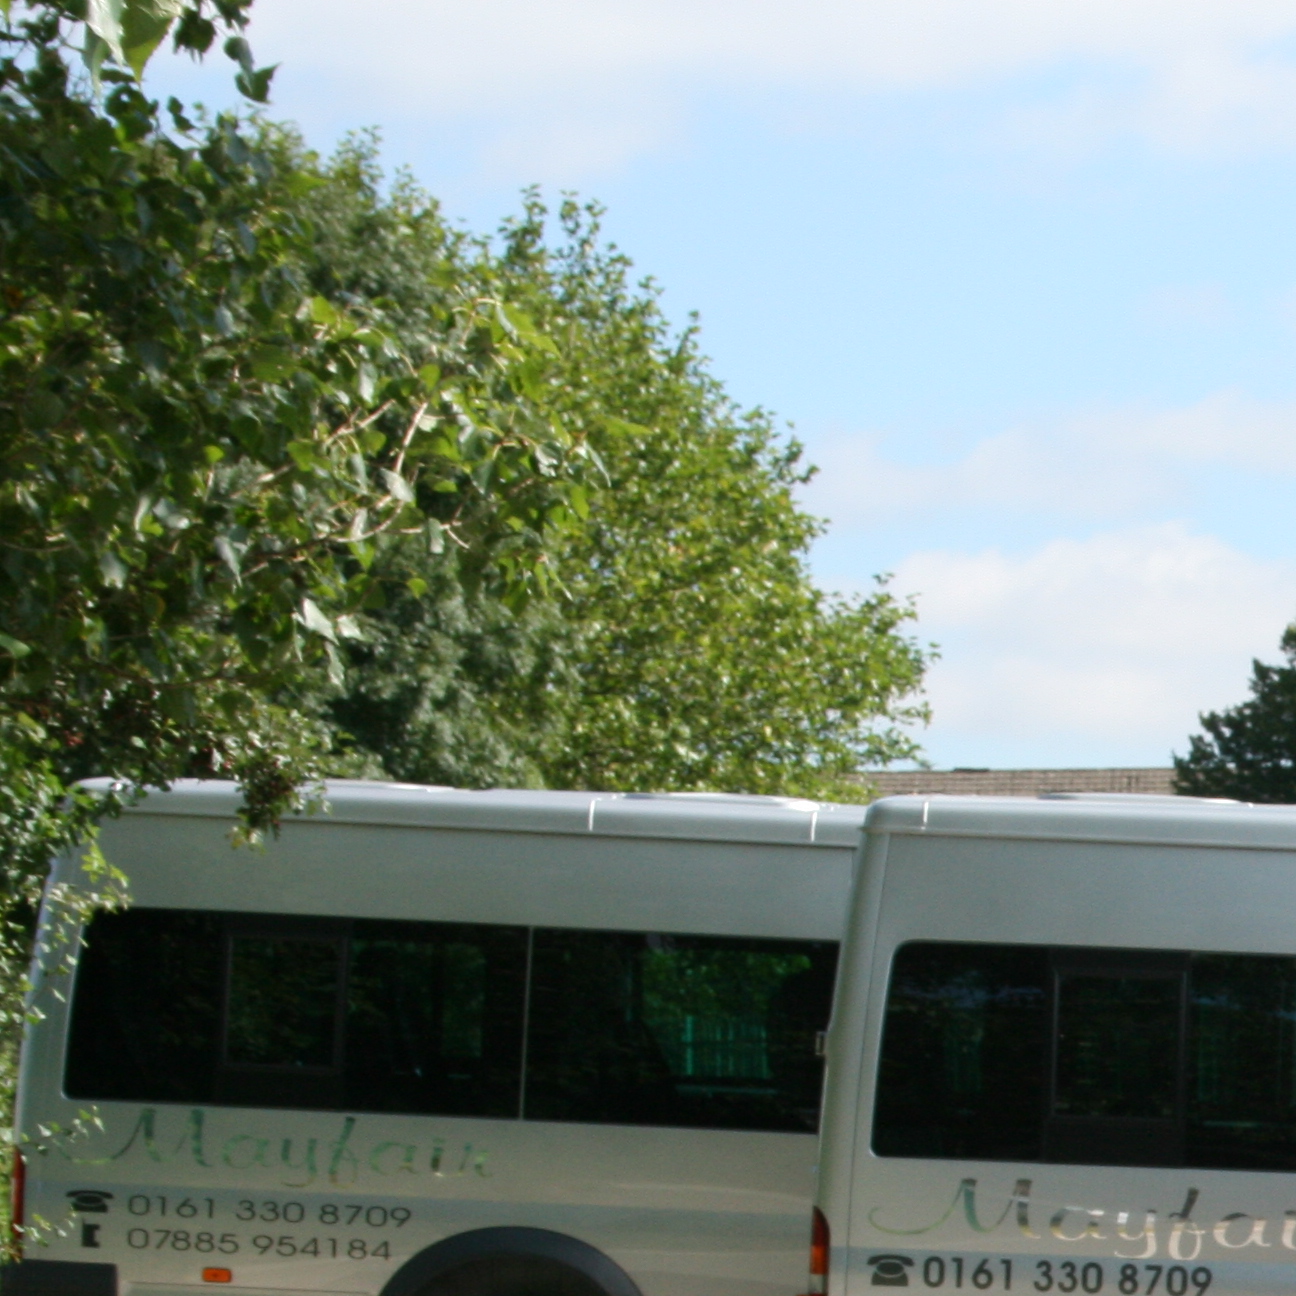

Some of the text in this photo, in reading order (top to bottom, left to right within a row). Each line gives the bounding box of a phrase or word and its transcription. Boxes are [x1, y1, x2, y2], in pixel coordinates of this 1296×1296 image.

[126, 1193, 412, 1229] 0161 330 8709
[126, 1227, 391, 1261] 07885 954184
[922, 1255, 1014, 1291] 0161
[1033, 1260, 1103, 1294] 330
